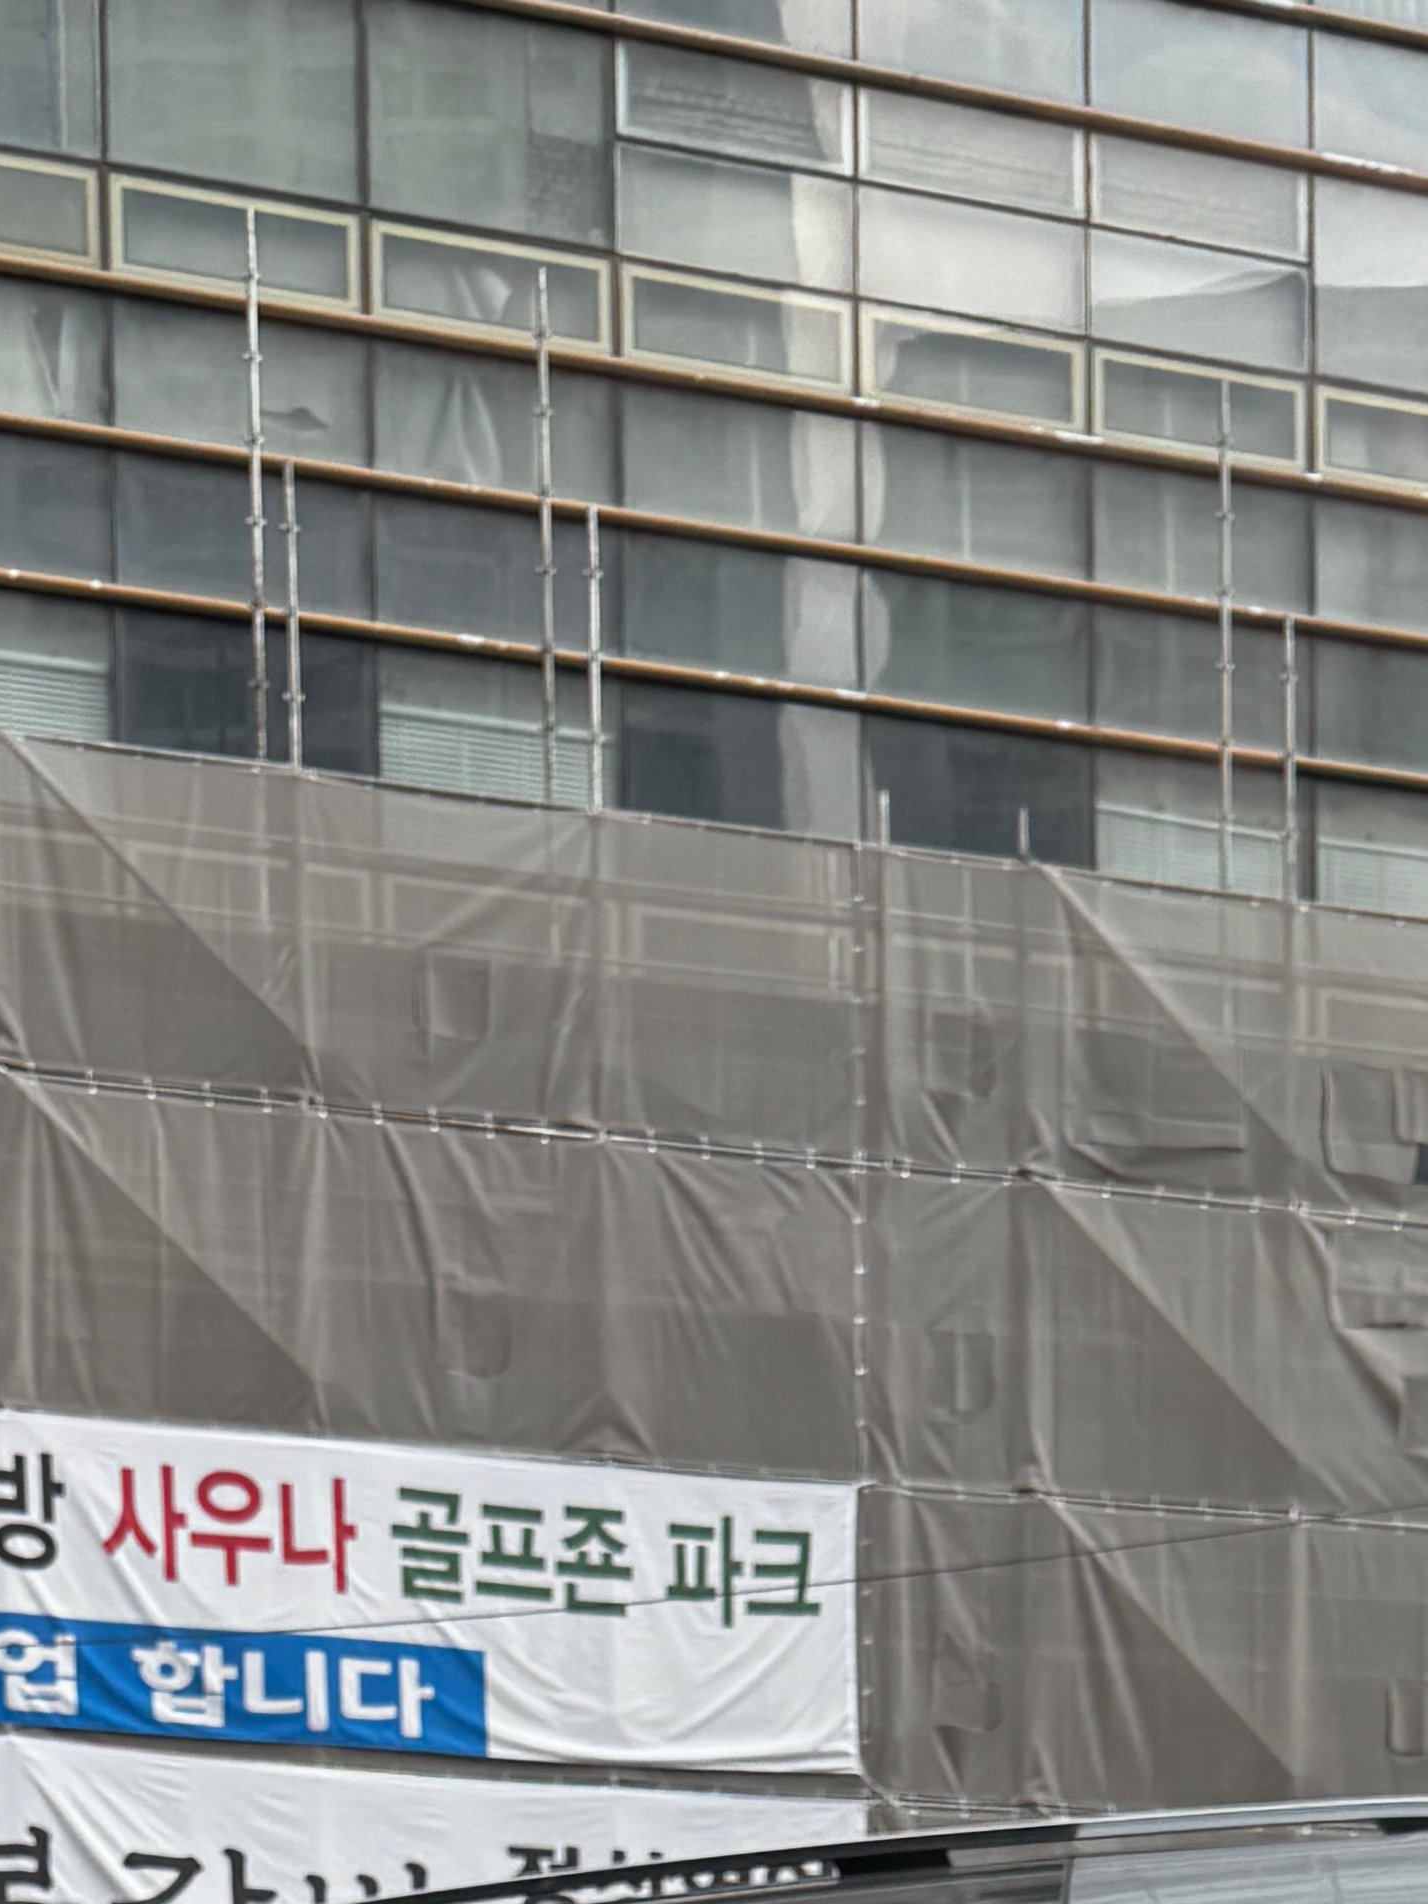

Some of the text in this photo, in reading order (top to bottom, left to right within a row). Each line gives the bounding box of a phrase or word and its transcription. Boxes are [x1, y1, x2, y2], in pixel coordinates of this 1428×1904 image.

[103, 1464, 358, 1594] 사우나
[391, 1486, 633, 1617] 골프죤
[667, 1515, 822, 1629] 파크
[131, 1640, 435, 1740] 합니다
